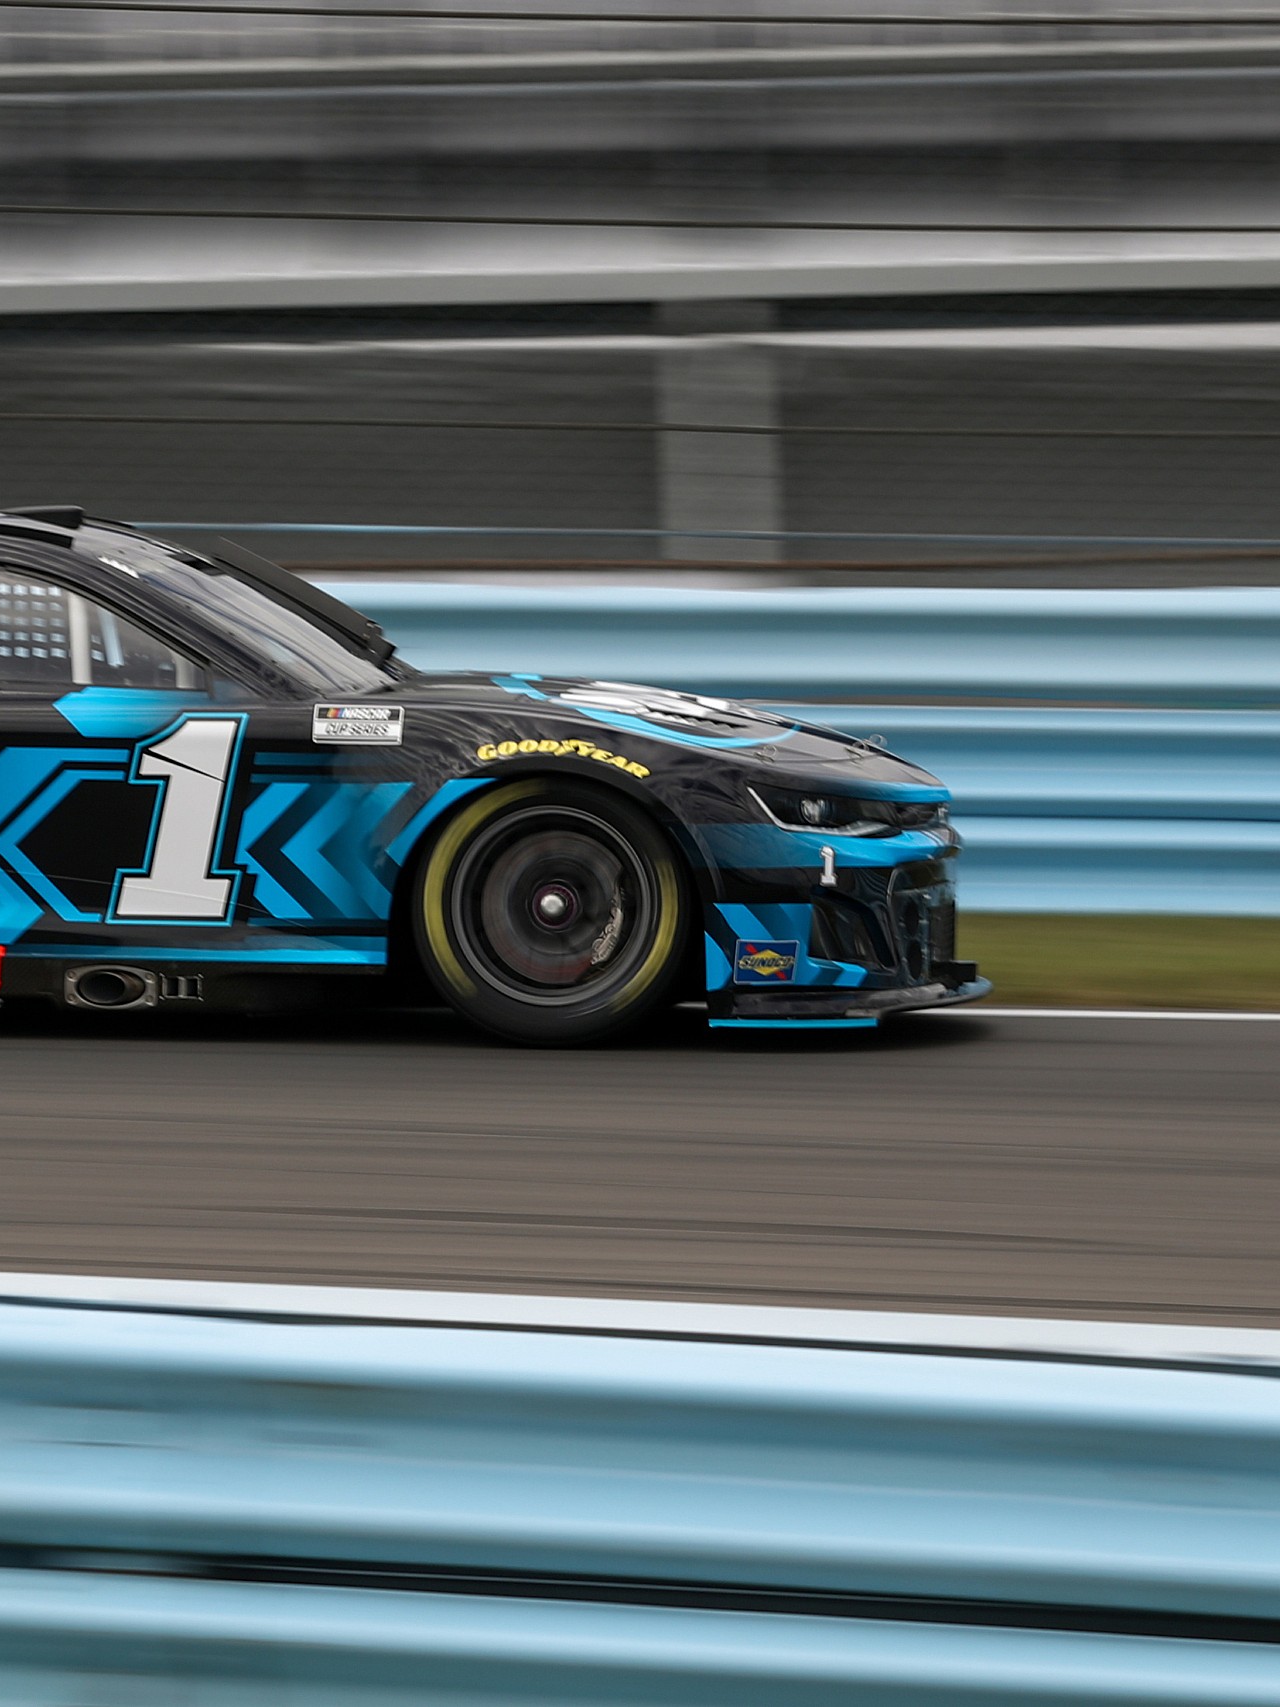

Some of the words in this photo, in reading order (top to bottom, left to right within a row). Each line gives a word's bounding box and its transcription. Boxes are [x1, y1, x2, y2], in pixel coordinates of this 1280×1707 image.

[477, 739, 651, 779] GOODYEAR
[115, 719, 238, 919] 1
[820, 846, 837, 887] 1
[739, 956, 794, 970] SUNOCO
